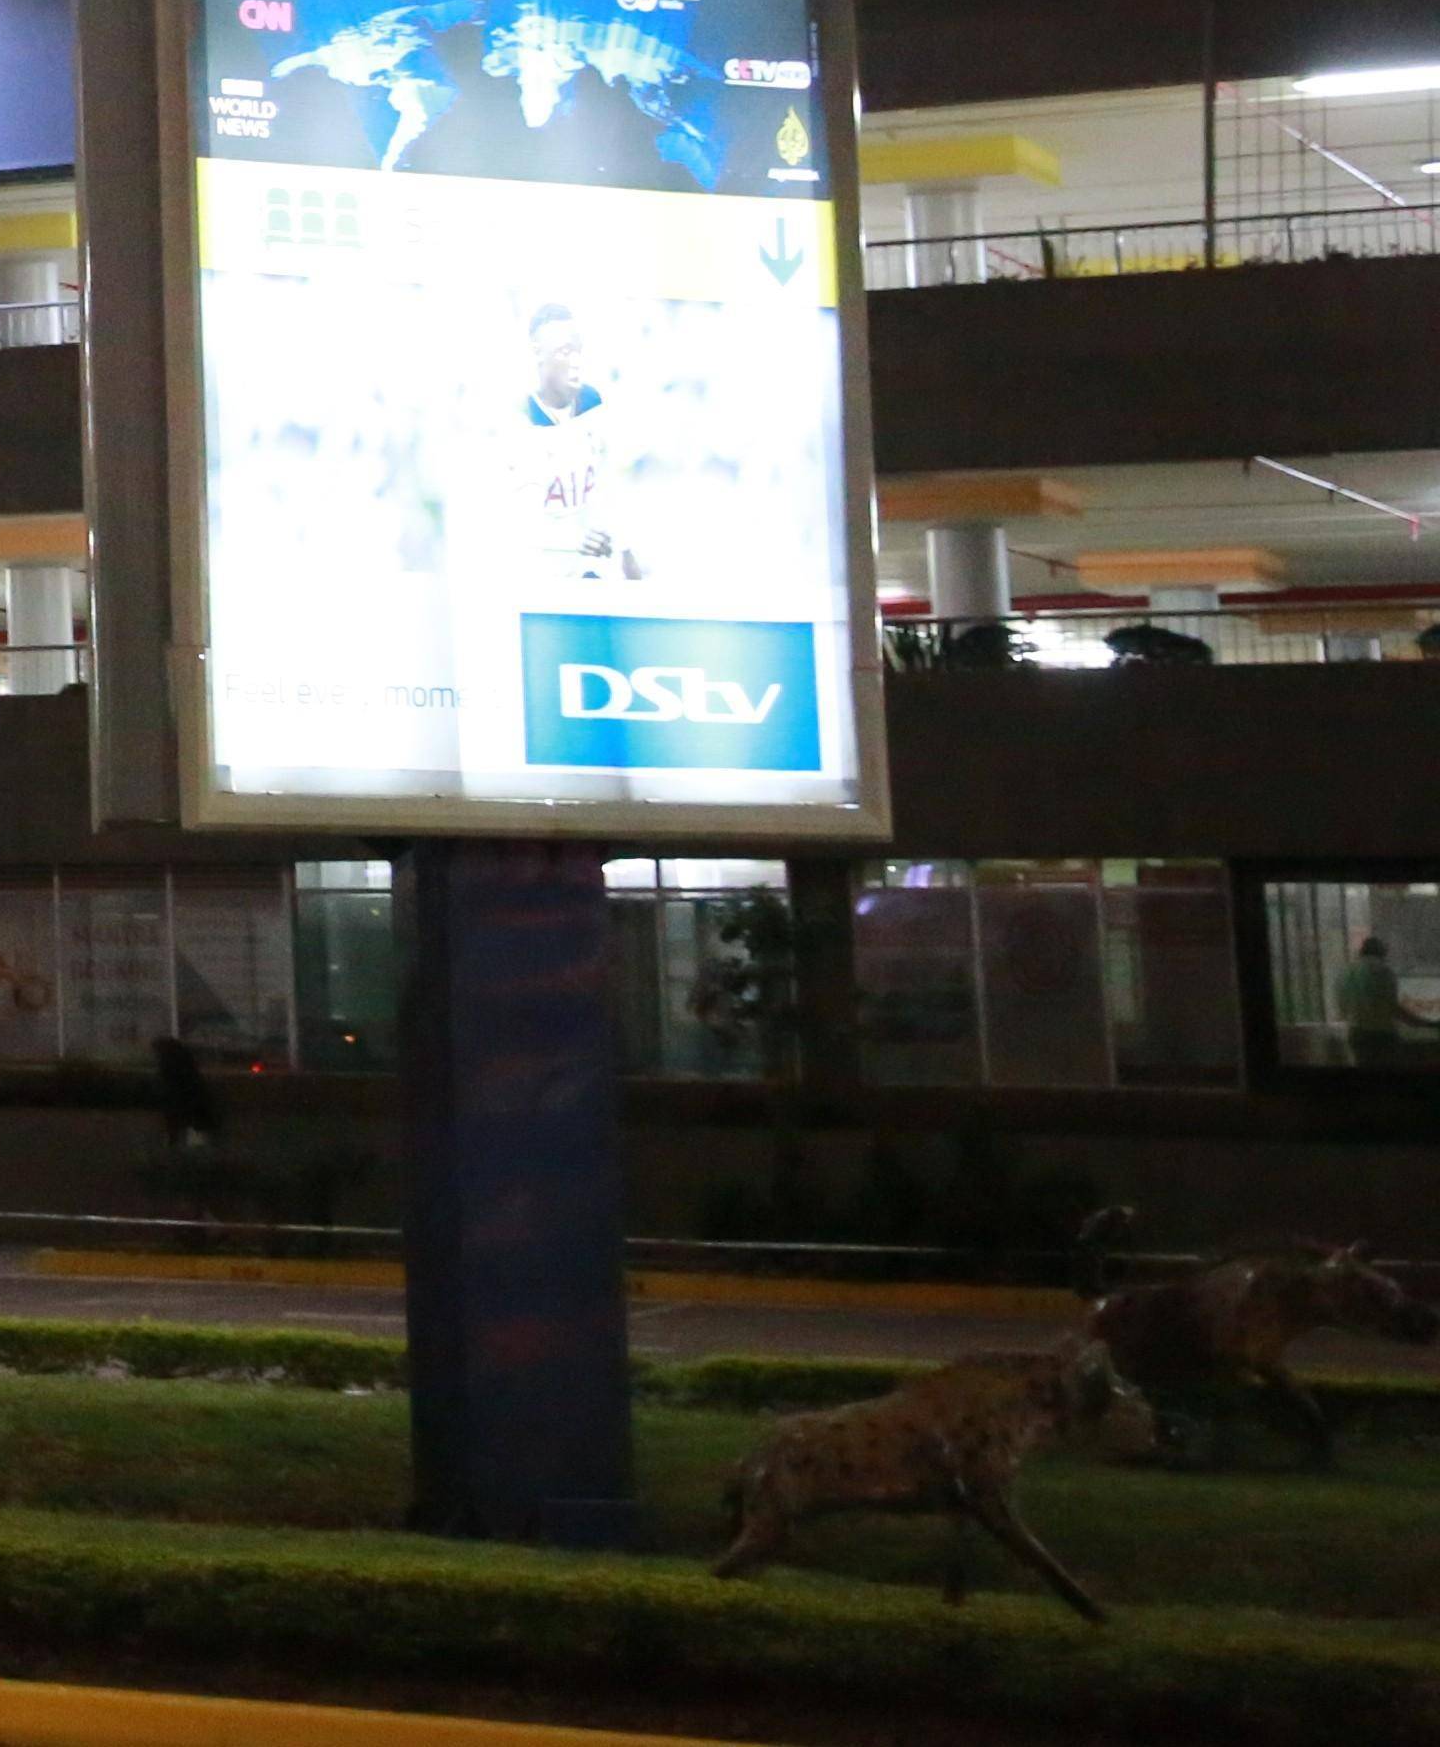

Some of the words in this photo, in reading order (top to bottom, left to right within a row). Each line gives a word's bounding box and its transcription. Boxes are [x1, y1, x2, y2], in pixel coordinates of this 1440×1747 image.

[209, 96, 277, 119] WORLD
[217, 117, 271, 139] NEWS
[559, 662, 782, 724] DStv
